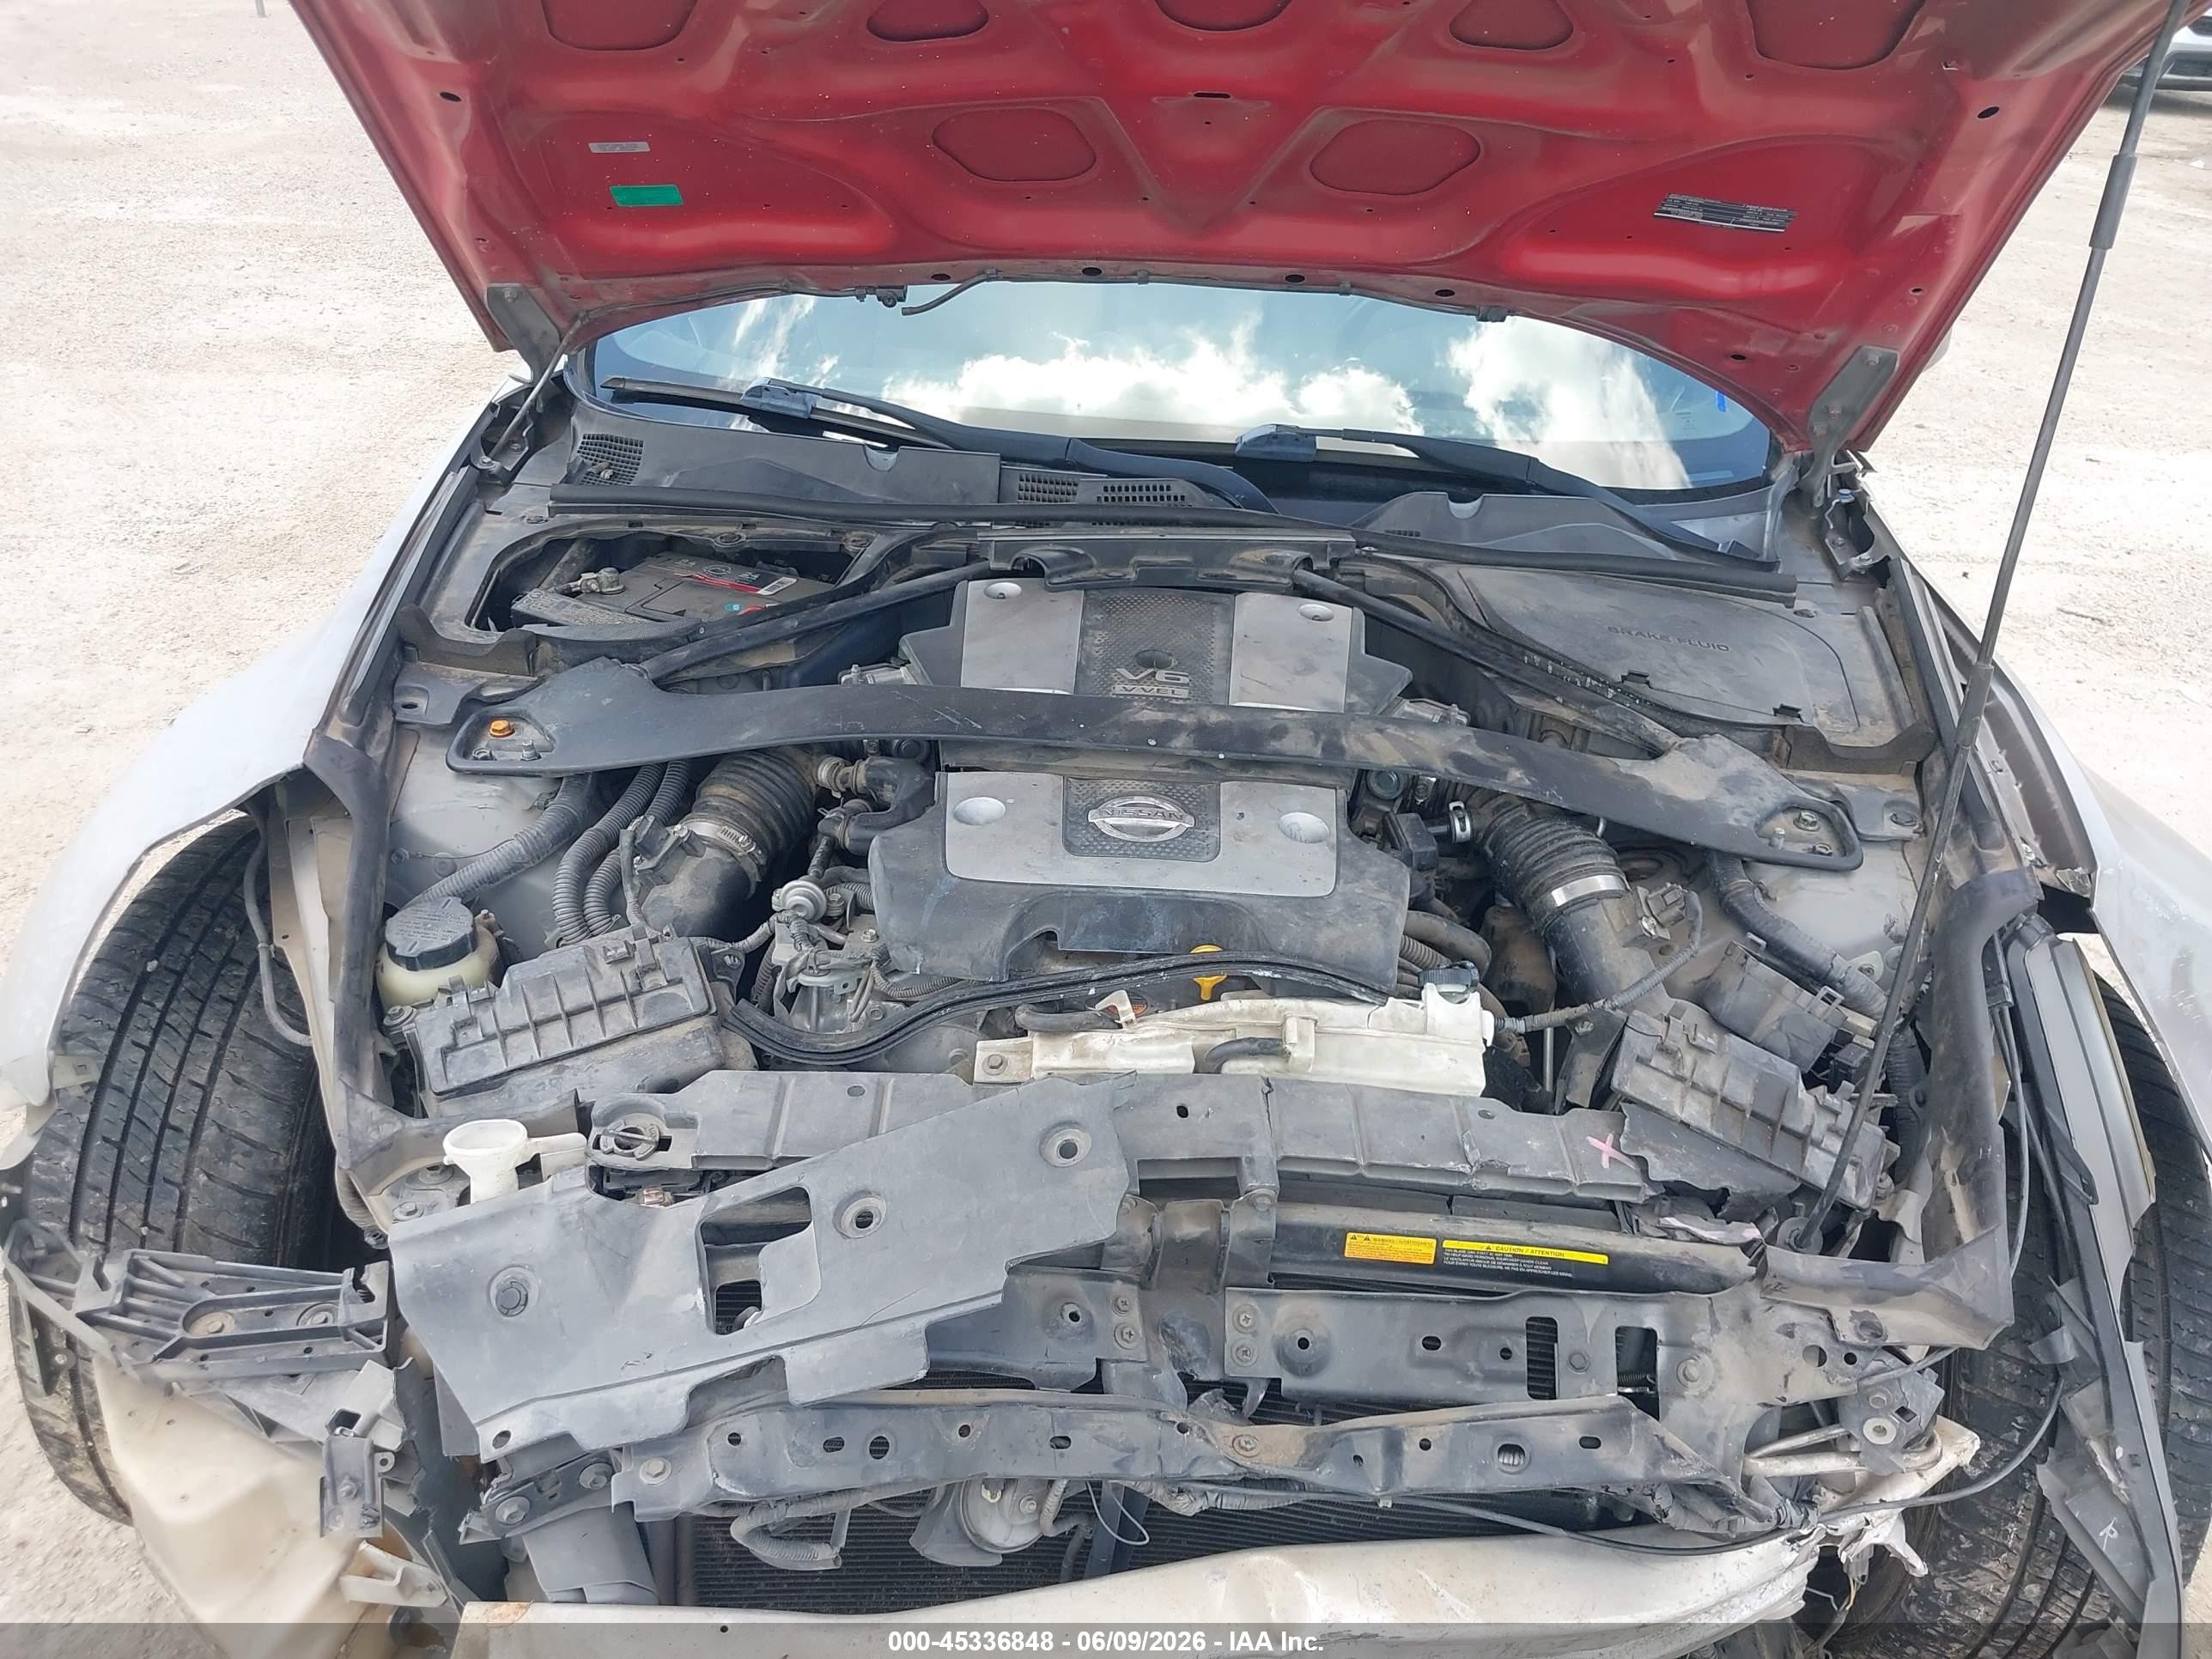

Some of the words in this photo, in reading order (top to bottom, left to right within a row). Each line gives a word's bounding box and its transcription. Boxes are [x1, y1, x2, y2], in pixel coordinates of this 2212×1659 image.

[1607, 626, 1672, 643] BRAKE
[1676, 637, 1729, 652] FLUID
[1115, 667, 1190, 686] V6
[1121, 686, 1184, 696] VVEL
[1101, 809, 1184, 820] NISSAN
[1496, 1245, 1523, 1254] CAUTION
